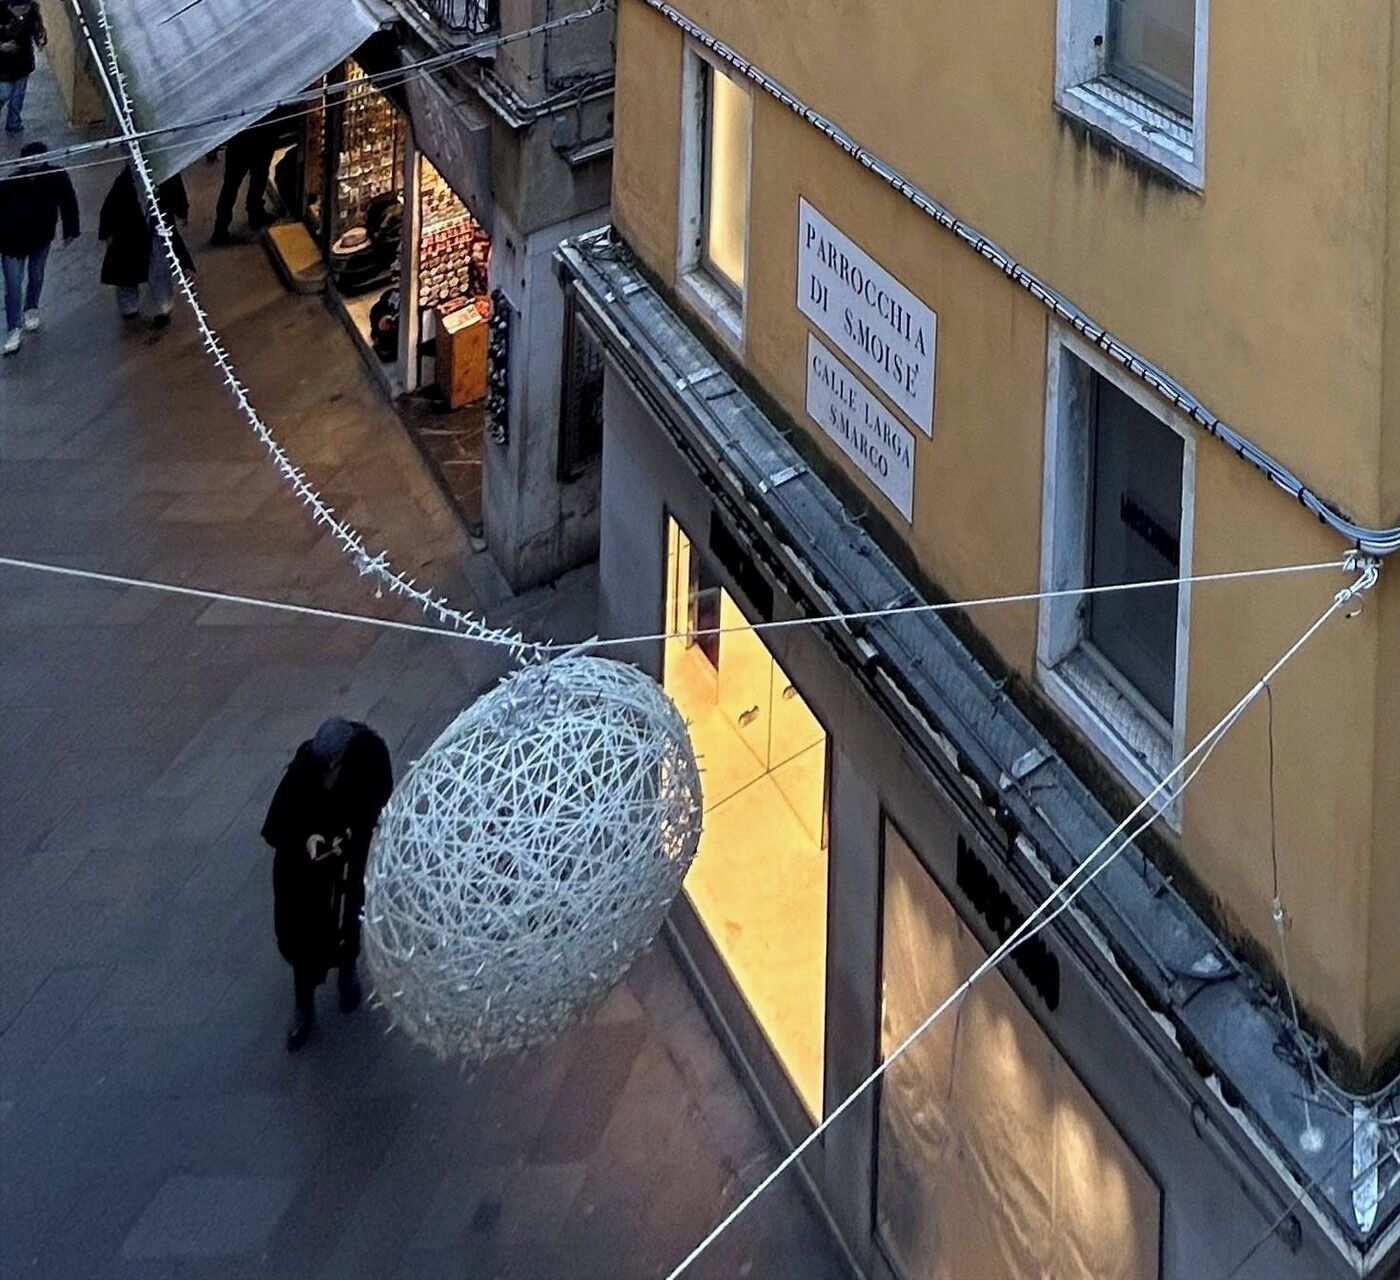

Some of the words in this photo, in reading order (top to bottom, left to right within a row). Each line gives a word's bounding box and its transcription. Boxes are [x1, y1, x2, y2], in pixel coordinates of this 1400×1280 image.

[806, 222, 927, 357] PARROCCHIA
[810, 274, 829, 313] DI
[812, 355, 857, 413] CALLE
[864, 402, 910, 470] LARGA
[829, 404, 888, 477] S.MARCO
